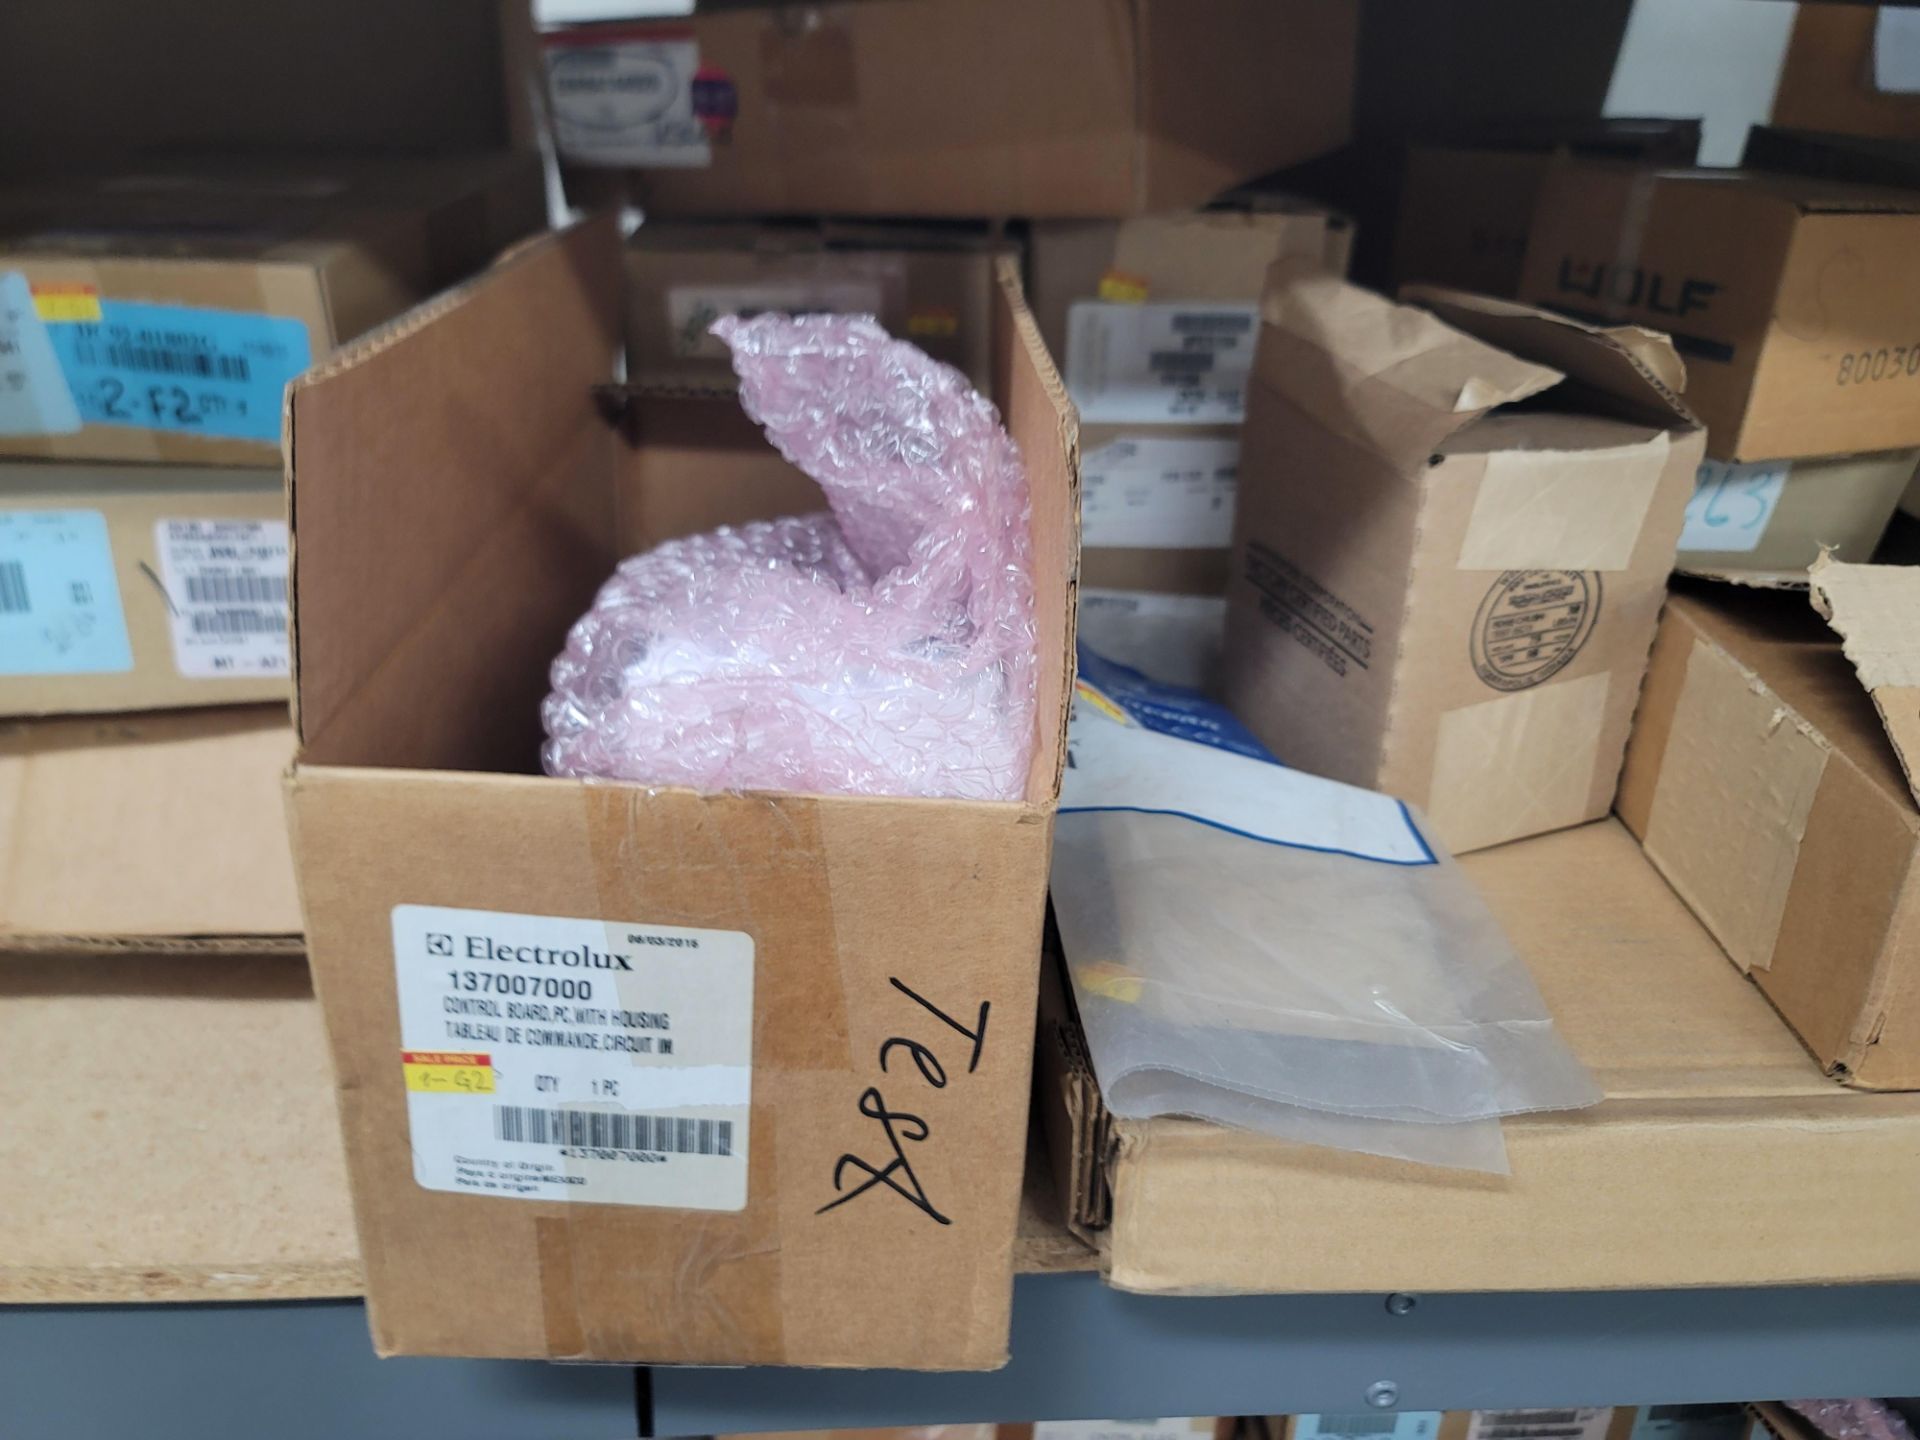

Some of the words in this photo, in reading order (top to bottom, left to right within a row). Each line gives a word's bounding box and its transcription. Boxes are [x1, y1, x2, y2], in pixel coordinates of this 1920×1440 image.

[1558, 254, 1722, 316] WOLF
[465, 935, 634, 971] Electrolux
[447, 969, 592, 1001] 137007000
[443, 995, 502, 1018] CONTROL
[611, 1008, 670, 1030] HOUSING
[445, 1020, 501, 1042] TABLEAU
[505, 1026, 522, 1044] DE
[534, 1074, 560, 1092] QTY
[591, 1079, 599, 1095] 1
[602, 1080, 620, 1097] PC
